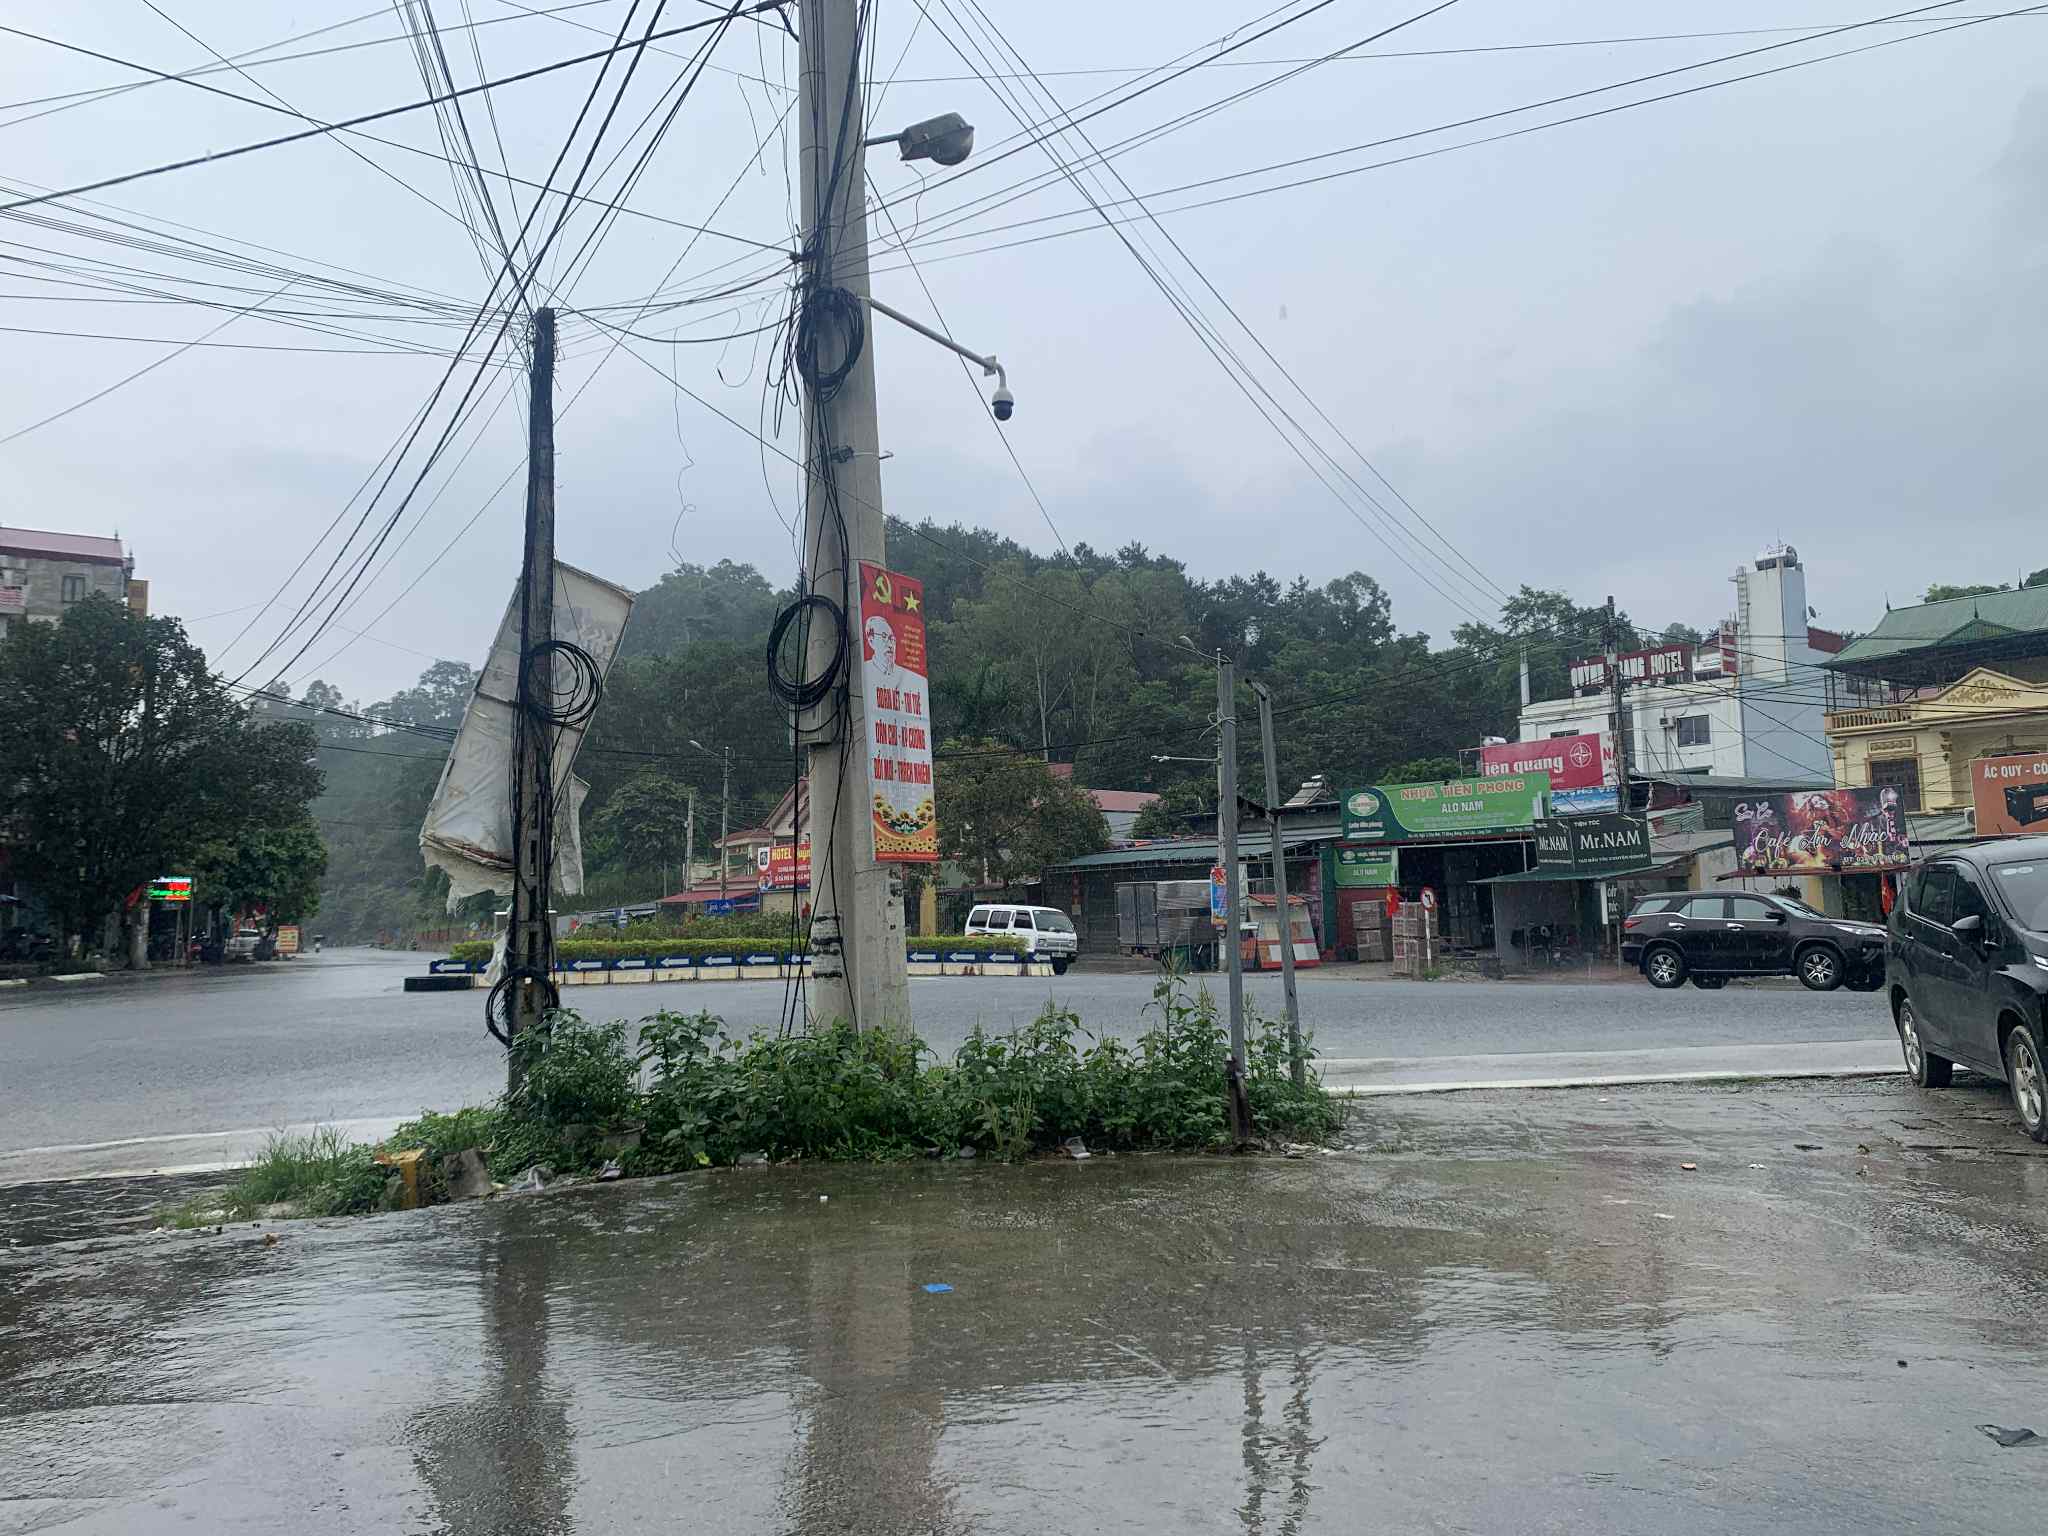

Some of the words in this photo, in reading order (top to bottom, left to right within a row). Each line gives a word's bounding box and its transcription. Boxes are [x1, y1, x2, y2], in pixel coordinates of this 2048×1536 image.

[1650, 651, 1684, 676] HOTEL
[1477, 779, 1526, 794] PHONG
[1461, 800, 1484, 813] NAM
[1579, 829, 1641, 850] Mr.NAM
[771, 847, 793, 861] HOTEL
